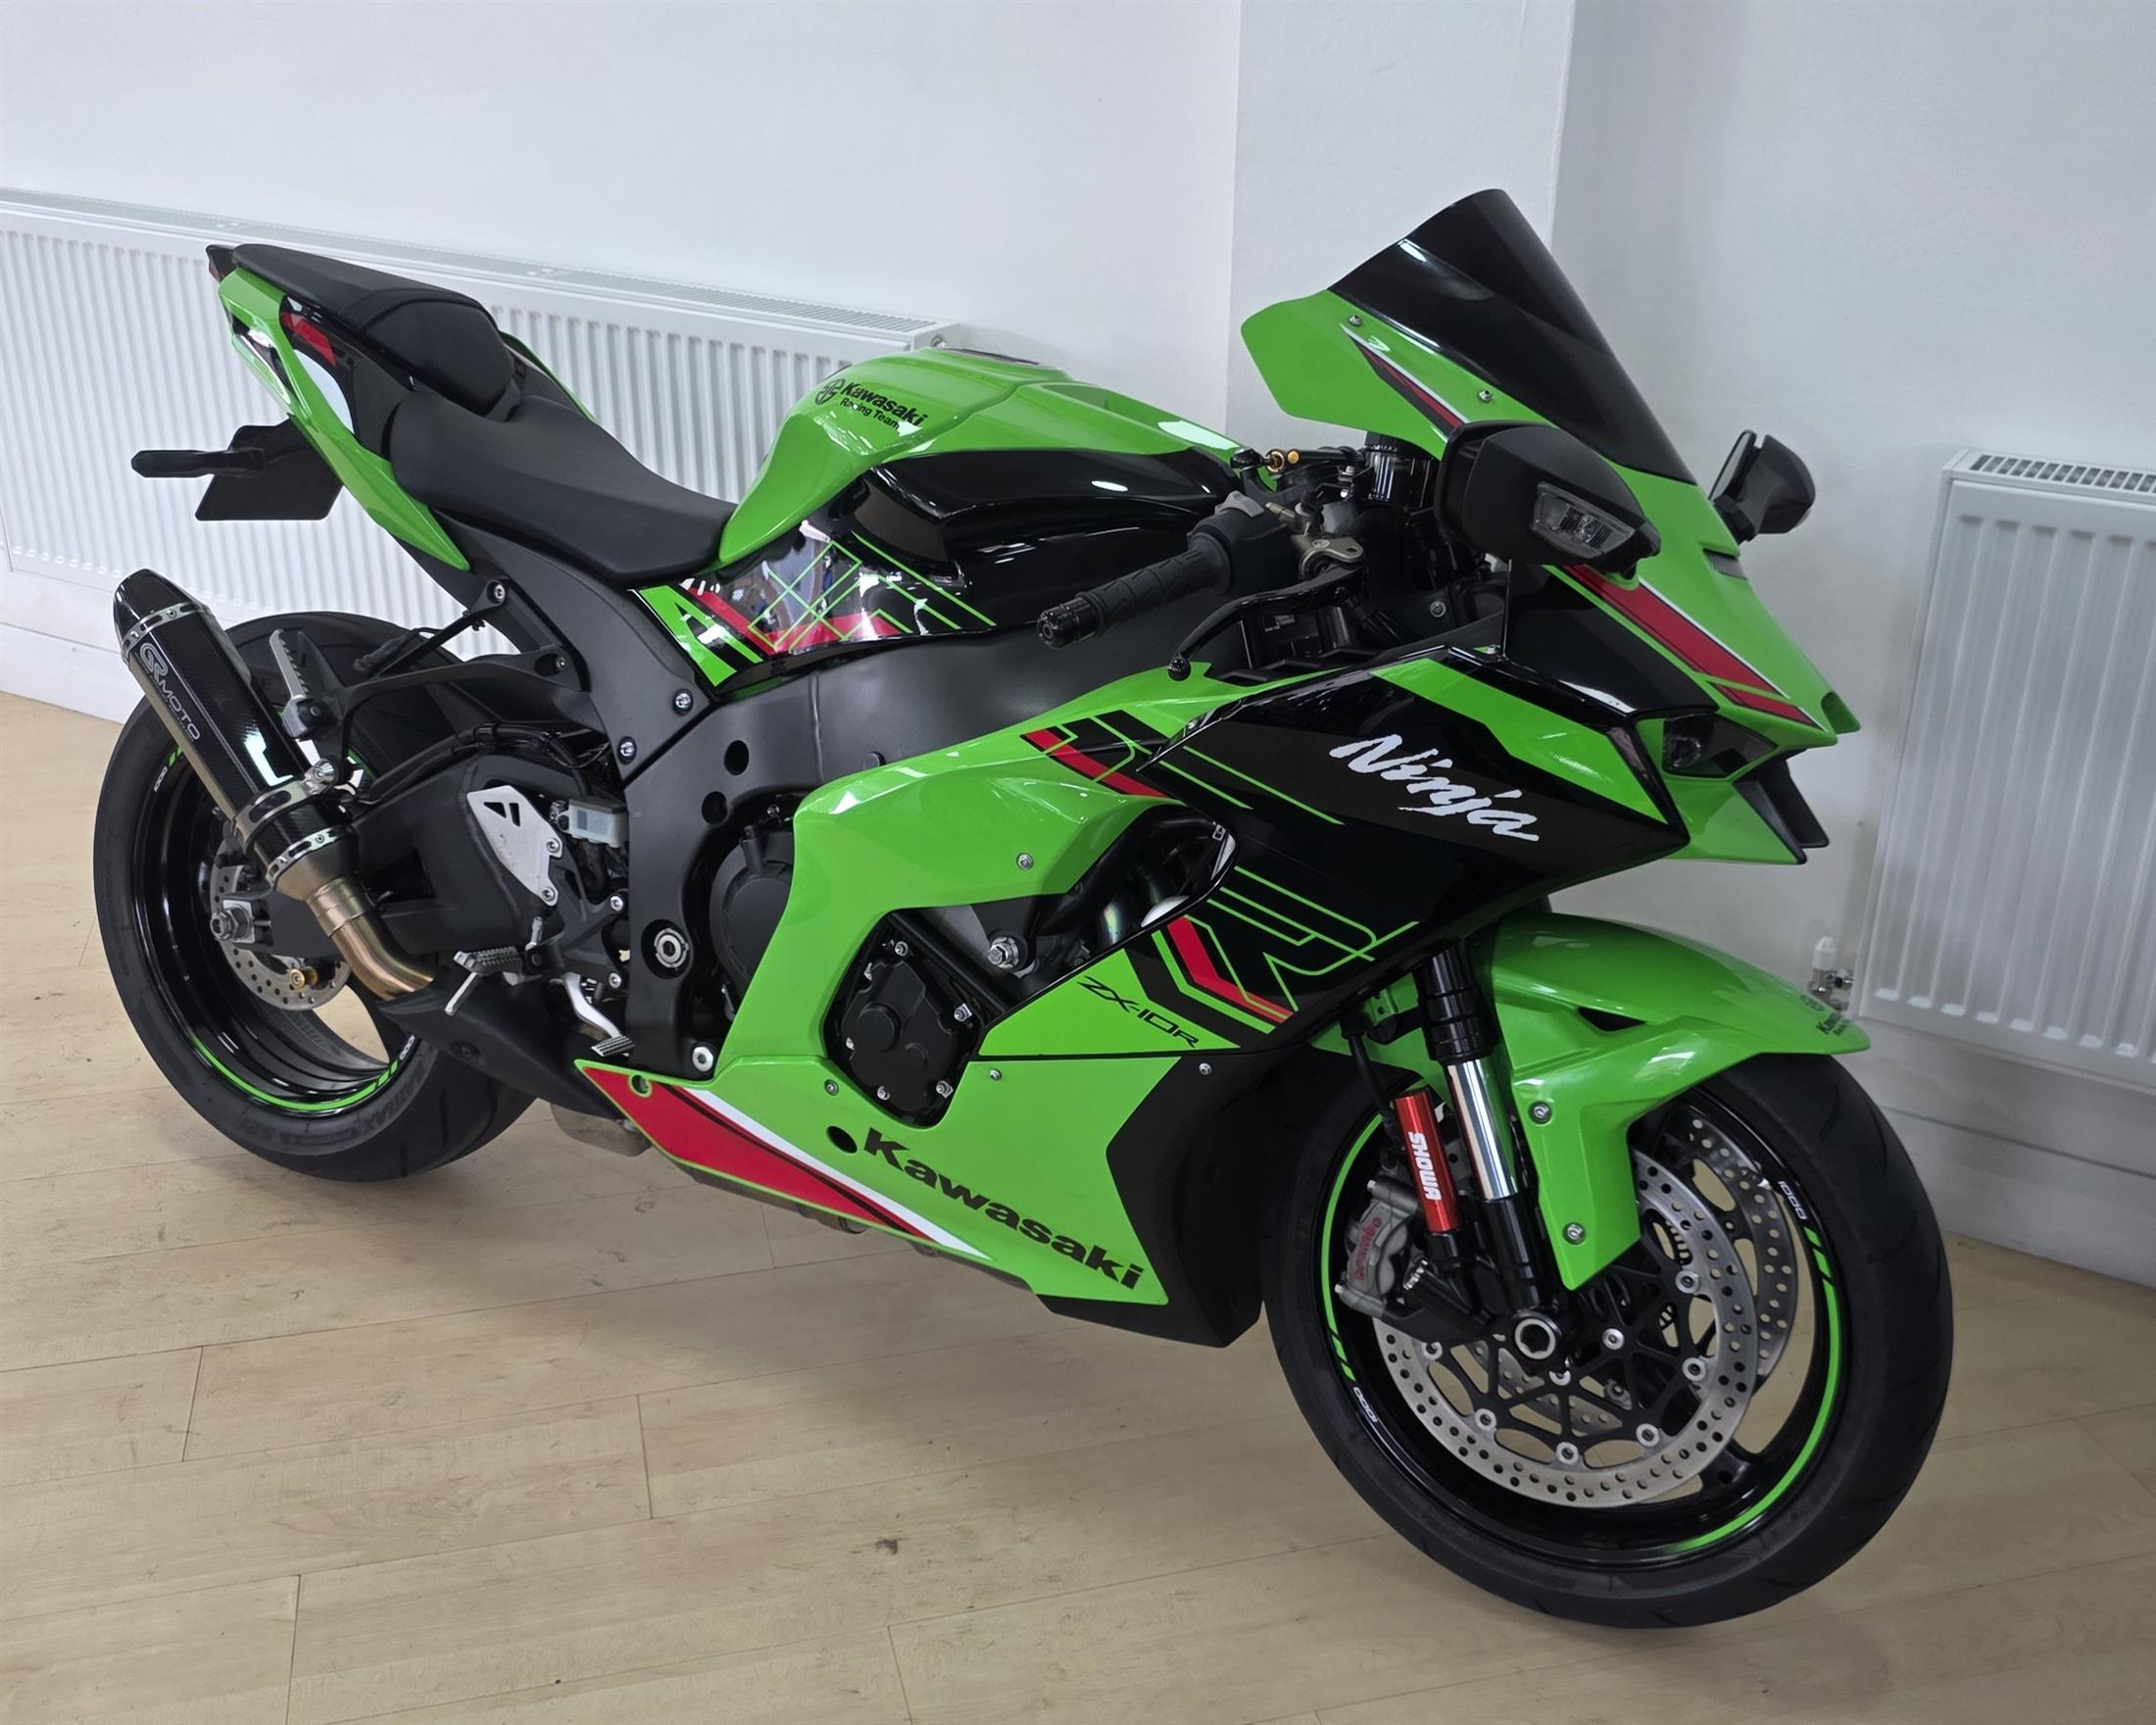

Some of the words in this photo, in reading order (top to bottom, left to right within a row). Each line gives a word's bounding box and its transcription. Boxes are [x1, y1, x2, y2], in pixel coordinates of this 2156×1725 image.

[840, 382, 928, 426] Kawasaki
[873, 410, 900, 431] Team
[1329, 734, 1540, 842] Ninja
[1077, 975, 1200, 1048] ZX-10R
[1408, 1131, 1443, 1201] SHOWA
[863, 1127, 1144, 1290] Kawasaki
